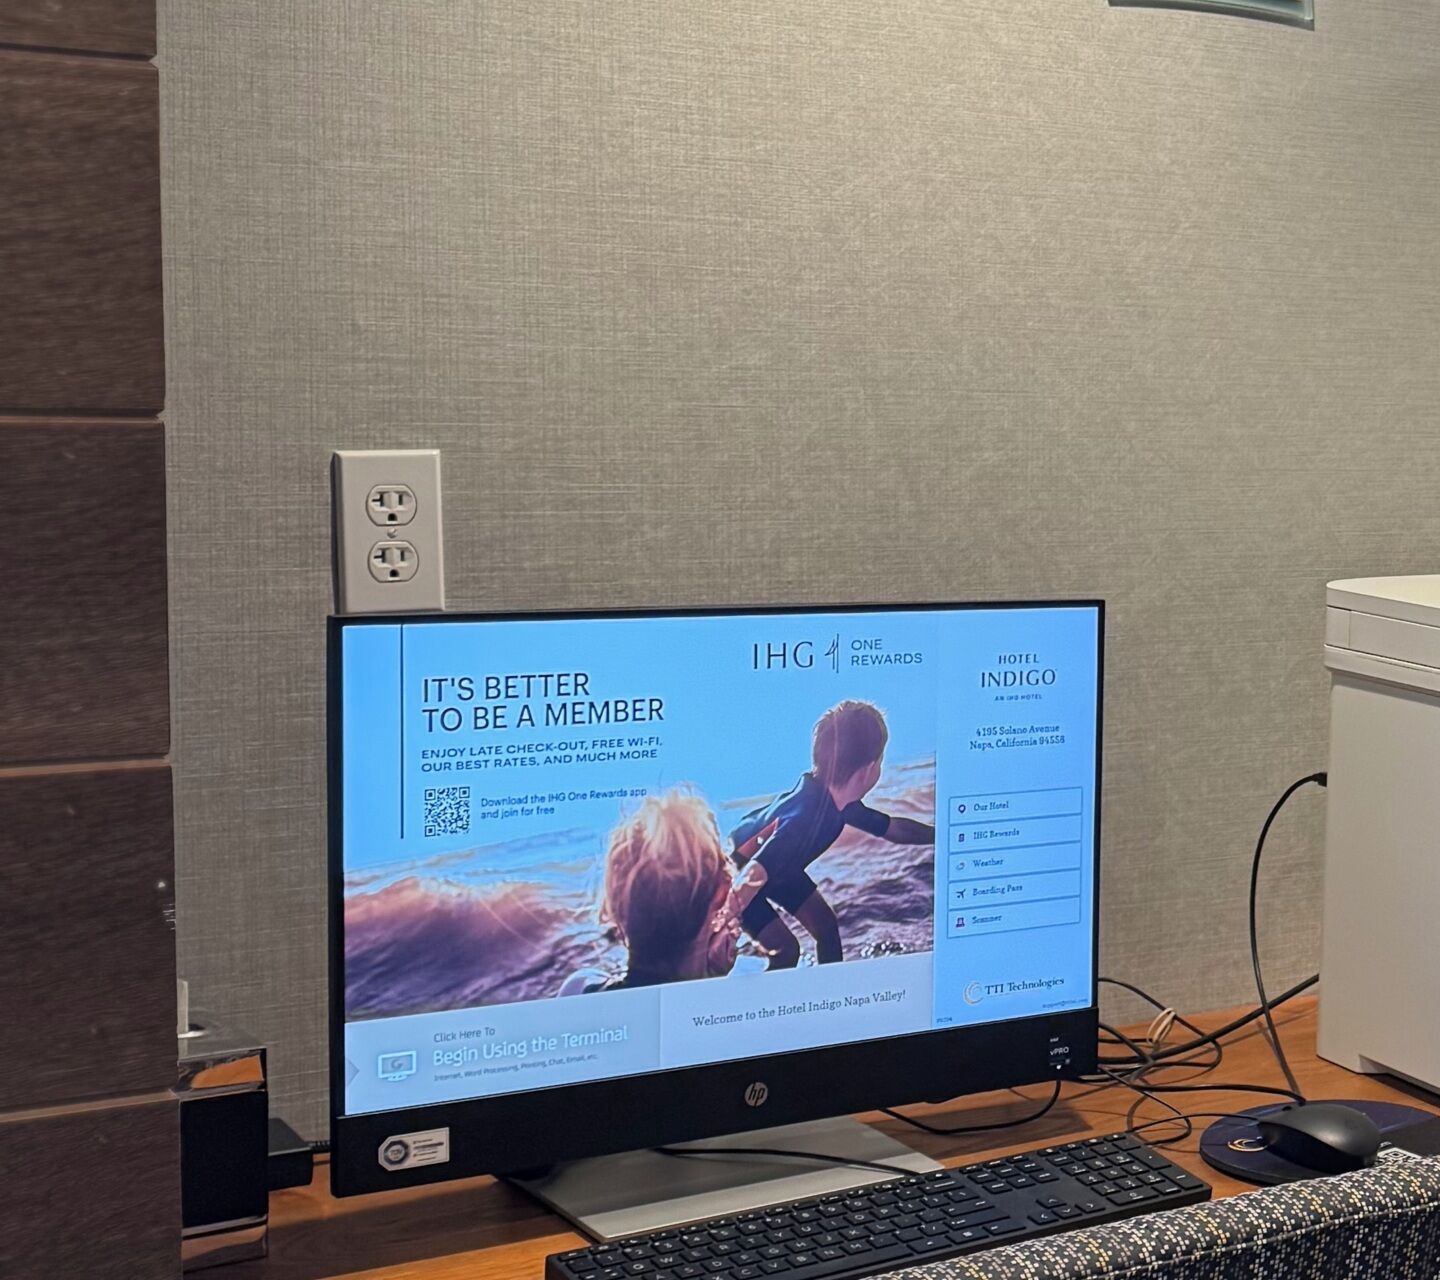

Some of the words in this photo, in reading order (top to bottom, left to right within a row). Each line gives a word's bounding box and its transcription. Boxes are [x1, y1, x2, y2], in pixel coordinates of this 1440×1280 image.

[850, 638, 883, 651] ONE
[753, 640, 814, 670] IHG
[850, 652, 923, 666] REWARDS
[998, 653, 1040, 665] HOTEL
[422, 676, 475, 703] IT'S
[484, 672, 590, 701] BETTER
[981, 668, 1056, 688] INDIGO
[422, 706, 463, 733] TO
[473, 705, 508, 730] BE
[516, 704, 536, 729] A
[545, 698, 665, 727] MEMBER
[1028, 724, 1060, 734] Avenue
[421, 746, 466, 759] ENJOY
[469, 745, 503, 757] LATE
[506, 740, 588, 755] CHECK-OUT,
[592, 738, 624, 750] FREE
[995, 736, 1038, 748] California
[421, 762, 452, 773] OUR
[456, 758, 491, 771] BEST
[493, 756, 540, 769] RATES,
[543, 754, 573, 765] AND
[576, 752, 616, 763] MUCH
[619, 749, 658, 760] MORE
[480, 794, 528, 808] Download
[530, 793, 546, 805] the
[548, 792, 566, 804] IHG
[567, 790, 588, 802] One
[589, 788, 628, 800] Rewards
[630, 787, 647, 798] app
[989, 801, 1010, 811] Hotel
[480, 808, 499, 820] and
[500, 807, 519, 821] join
[520, 806, 535, 818] for
[536, 805, 555, 816] free
[989, 828, 1021, 838] Rewards
[973, 858, 1004, 867] Weather
[972, 885, 1005, 897] Boarding
[985, 982, 1004, 996] TTI
[1006, 976, 1065, 993] Technologies
[692, 1012, 743, 1028] Welcome
[745, 1010, 757, 1021] to
[758, 1007, 775, 1019] the
[777, 1002, 806, 1017] Hotel
[808, 998, 842, 1014] Indigo
[844, 995, 871, 1009] Napa
[872, 989, 907, 1004] Valley!
[434, 1030, 457, 1044] Click
[459, 1028, 482, 1040] Here
[484, 1026, 496, 1037] To
[433, 1046, 478, 1068] Begin
[482, 1038, 528, 1060] Using
[531, 1035, 557, 1054] the
[561, 1024, 629, 1049] Terminal
[746, 1082, 768, 1107] hp
